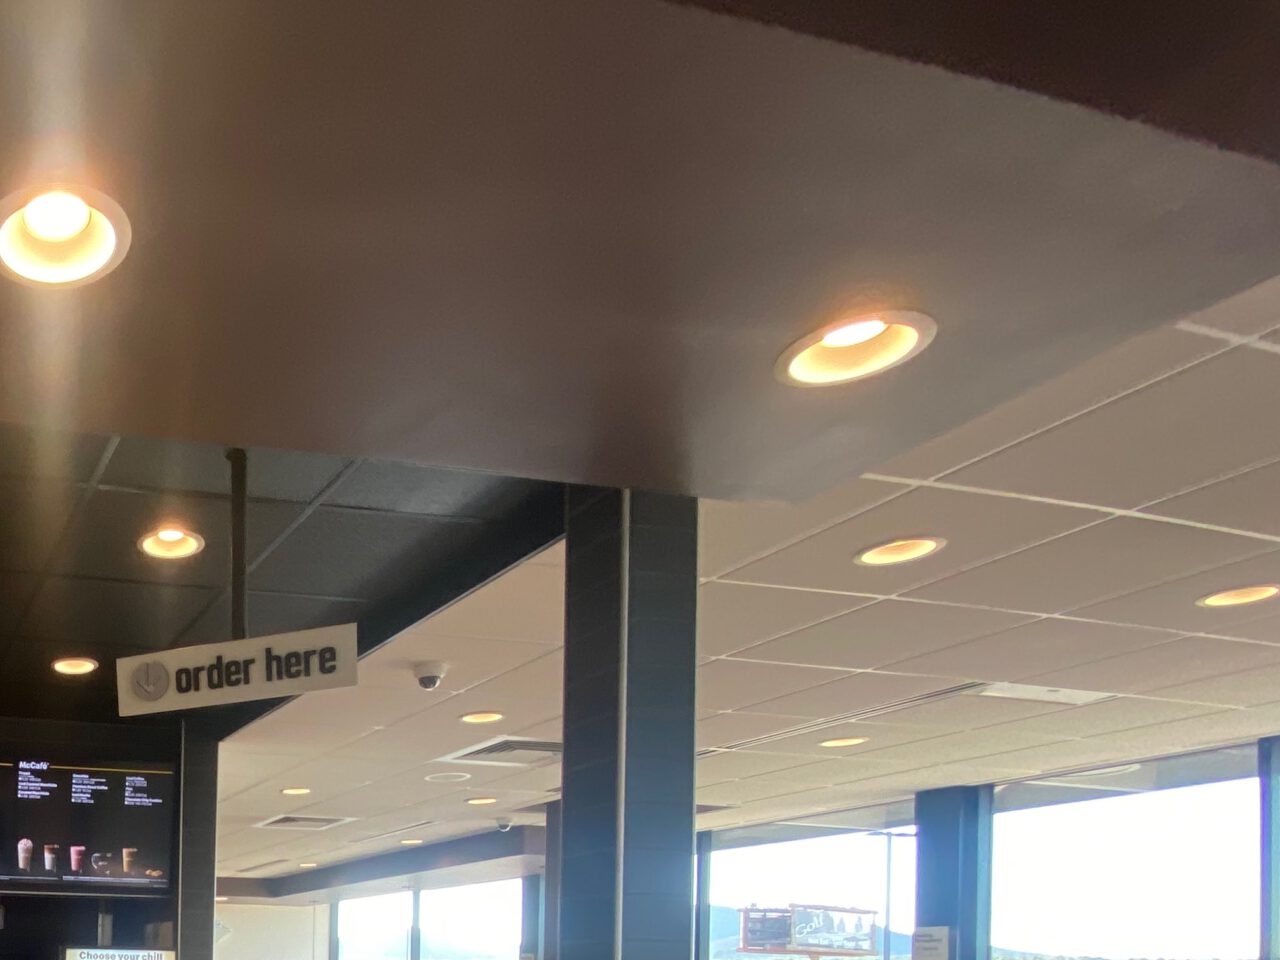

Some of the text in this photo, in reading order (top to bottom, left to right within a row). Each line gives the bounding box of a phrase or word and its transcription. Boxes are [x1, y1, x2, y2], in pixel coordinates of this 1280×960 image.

[175, 646, 337, 693] order here
[79, 951, 116, 960] Choose
[141, 953, 163, 960] chill
